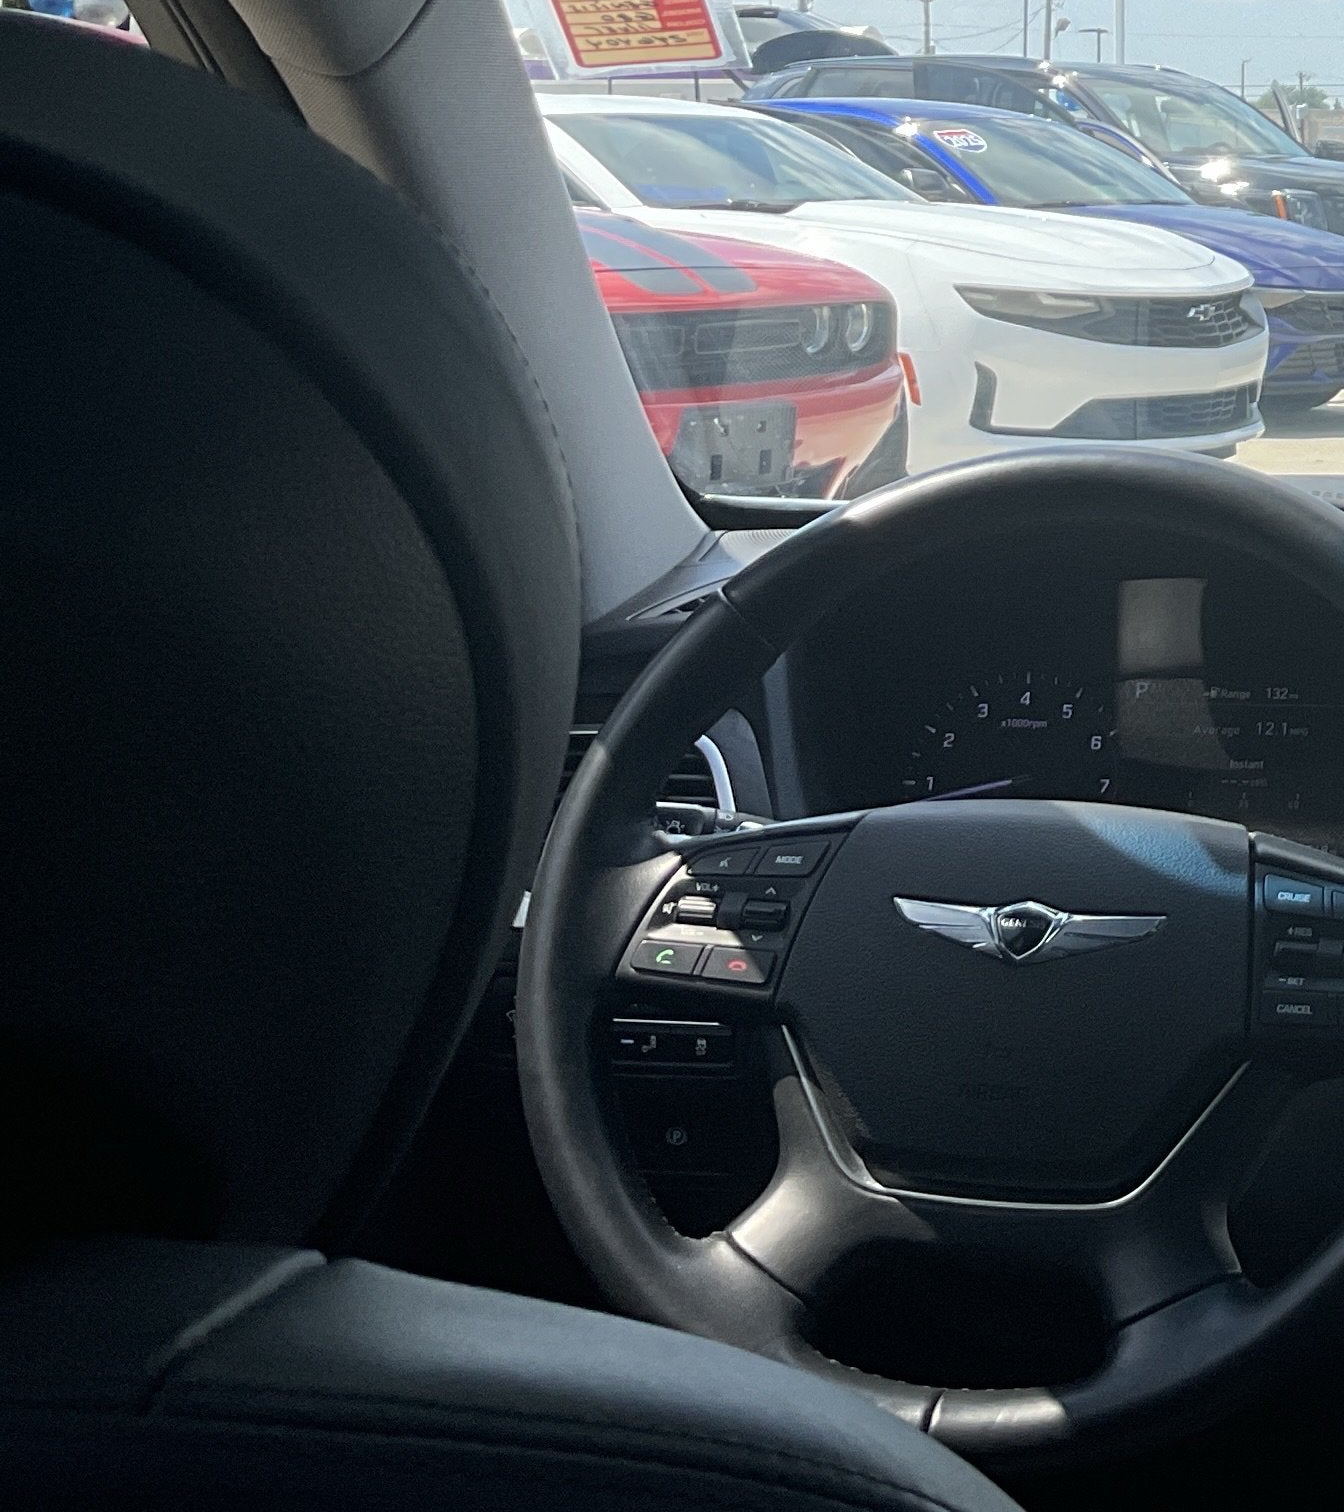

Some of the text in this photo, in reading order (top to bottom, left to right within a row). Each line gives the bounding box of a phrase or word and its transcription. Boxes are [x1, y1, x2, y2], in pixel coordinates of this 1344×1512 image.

[1134, 682, 1149, 699] P
[1020, 691, 1031, 706] 4
[977, 703, 989, 718] 3
[1062, 703, 1074, 719] 5
[1193, 724, 1241, 737] Average
[943, 732, 955, 748] 2
[1090, 735, 1102, 750] 6
[1229, 759, 1265, 769] Instant
[926, 775, 935, 791] 1
[1101, 778, 1111, 793] 7
[775, 855, 804, 865] MODE
[1277, 891, 1312, 903] CRUISE
[1276, 1004, 1313, 1015] CANCEL
